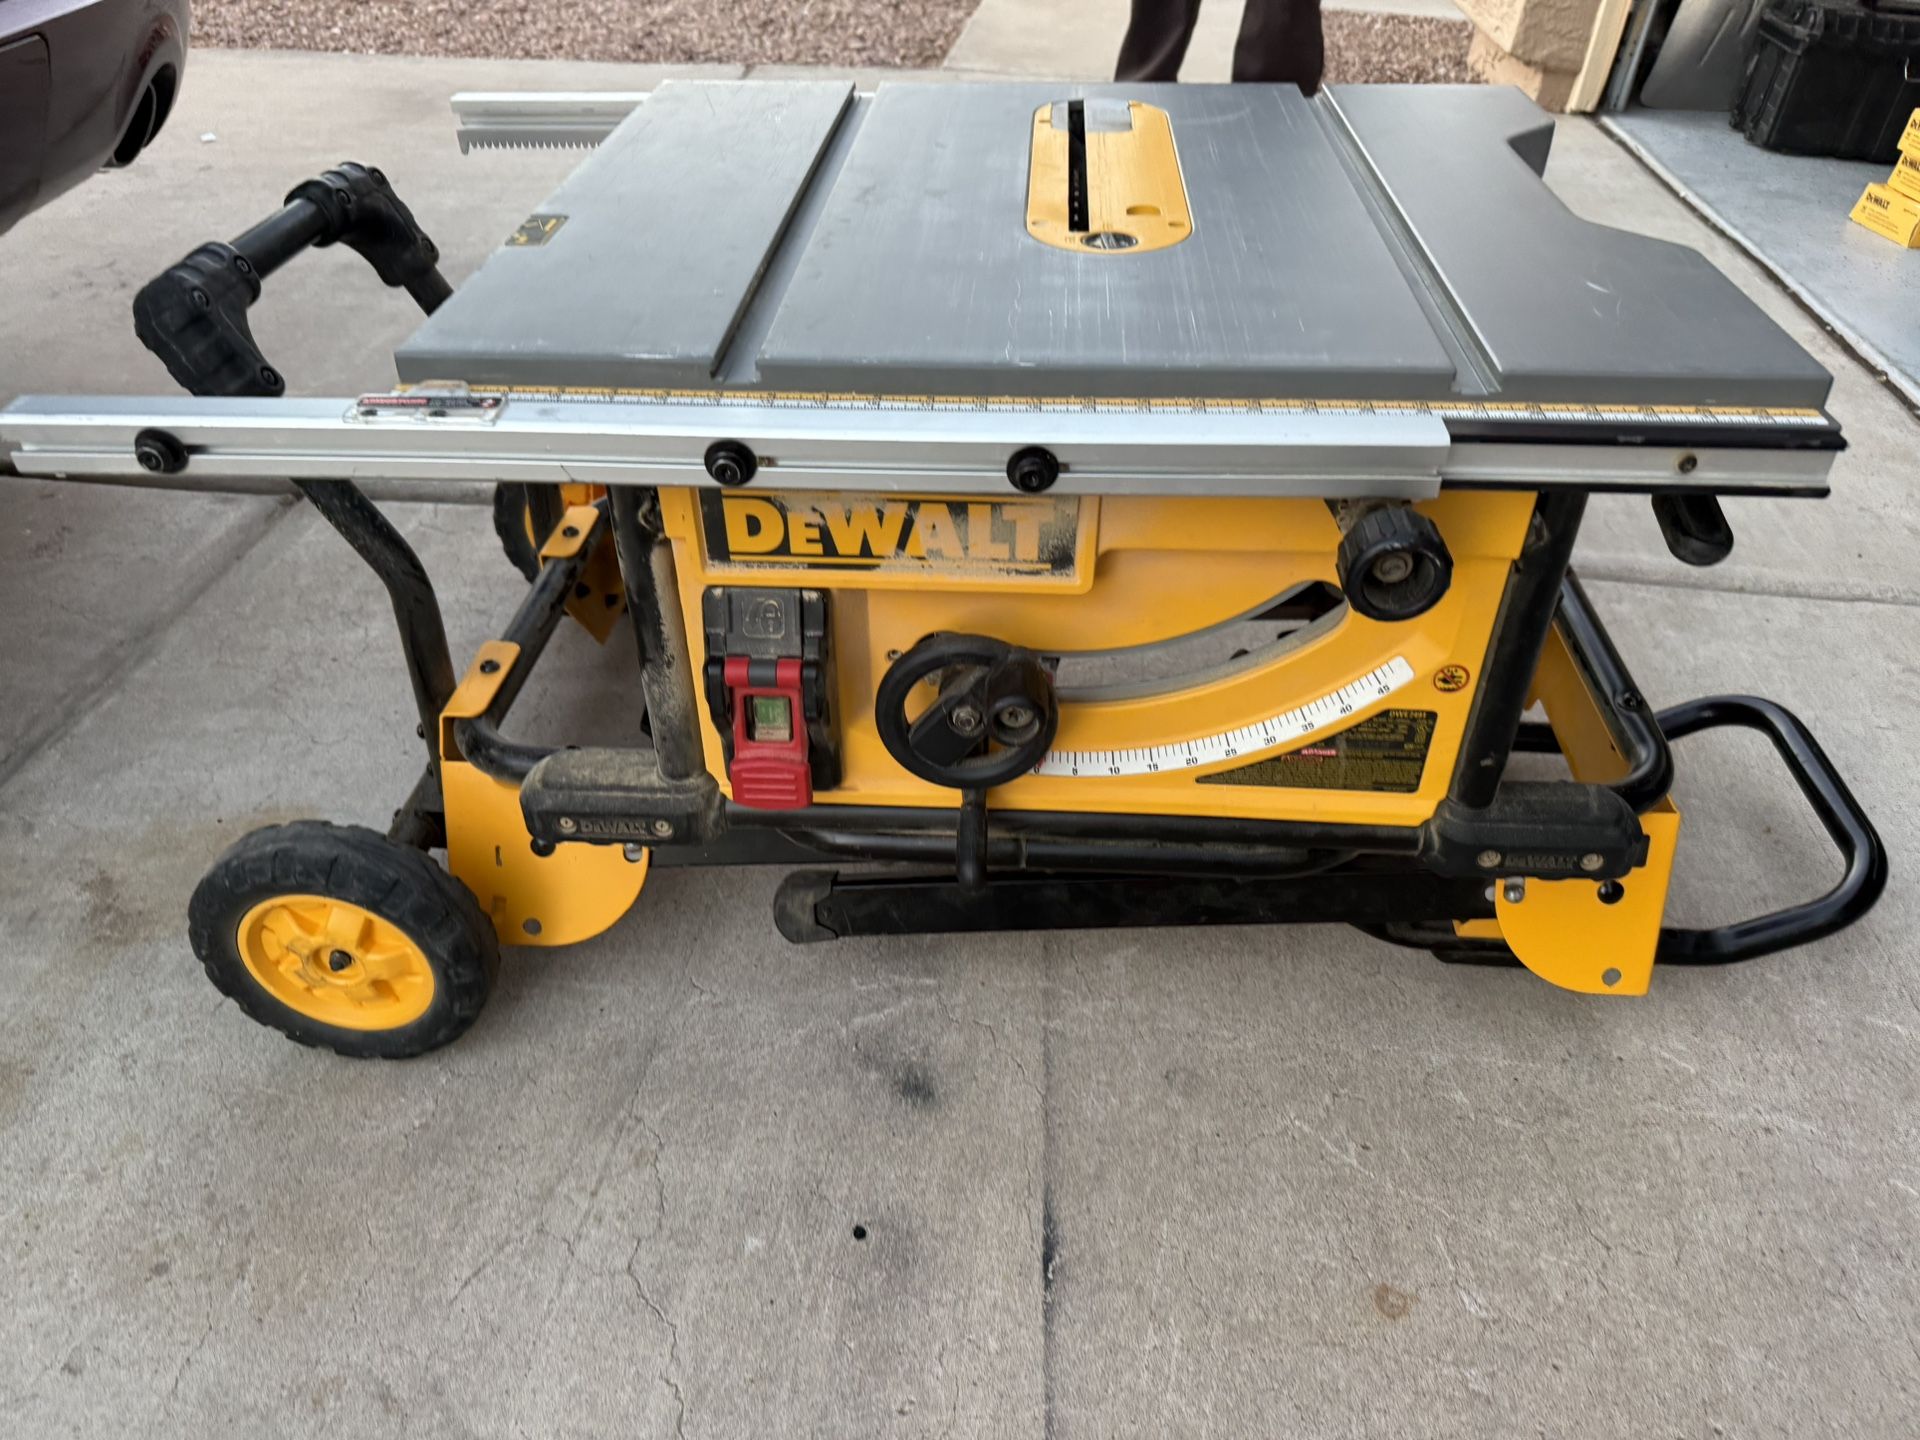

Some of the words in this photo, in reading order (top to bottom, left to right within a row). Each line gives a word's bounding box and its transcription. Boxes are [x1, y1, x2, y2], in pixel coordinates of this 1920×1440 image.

[724, 499, 1054, 561] DEWALT
[1377, 685, 1390, 695] 45
[1340, 704, 1353, 715] 40
[1302, 722, 1315, 732] 35
[1264, 736, 1277, 746] 30
[1225, 748, 1237, 758] 25
[1185, 757, 1198, 766] 20
[1108, 766, 1120, 775] 10
[1147, 763, 1159, 772] 15
